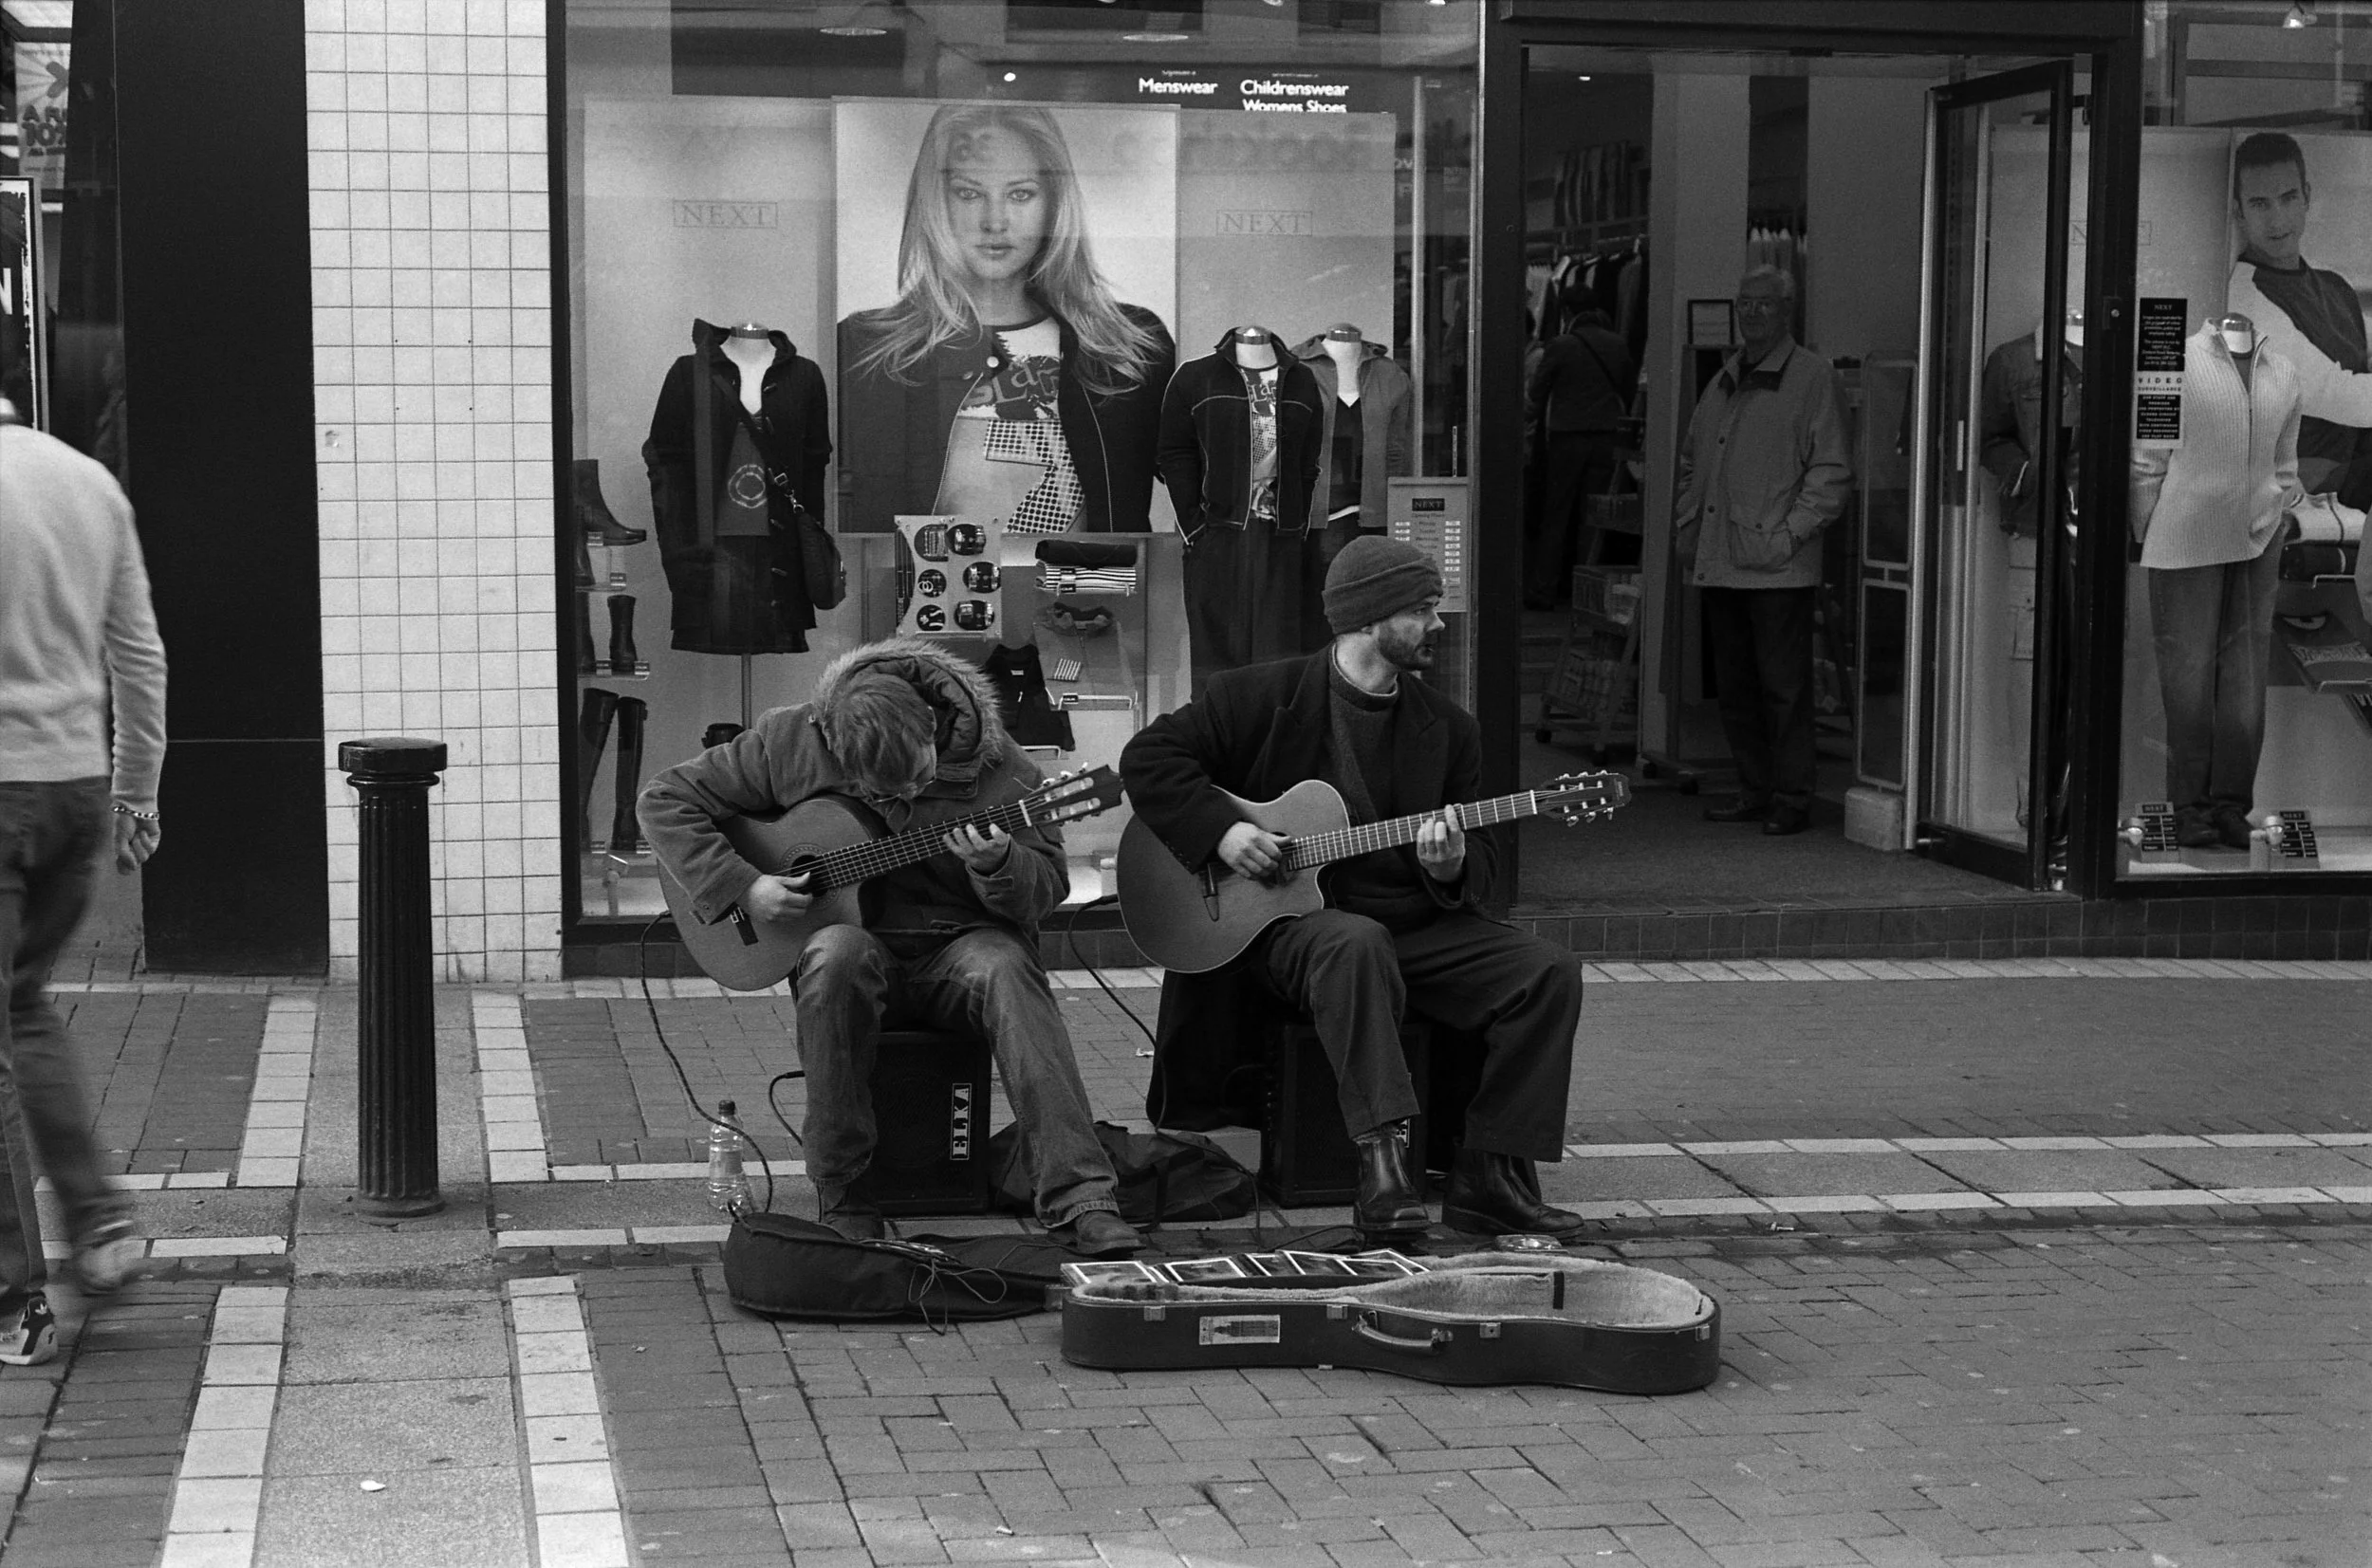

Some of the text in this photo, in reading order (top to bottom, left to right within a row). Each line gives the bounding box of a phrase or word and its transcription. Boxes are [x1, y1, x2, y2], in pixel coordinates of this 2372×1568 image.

[1138, 78, 1218, 95] Menswear
[1239, 79, 1349, 96] Childrenswear
[1242, 99, 1347, 113] Womens Shoes
[680, 203, 772, 226] NEXT
[1221, 212, 1308, 233] NEXT
[1415, 500, 1442, 508] NEXT
[953, 1087, 969, 1155] ELKA
